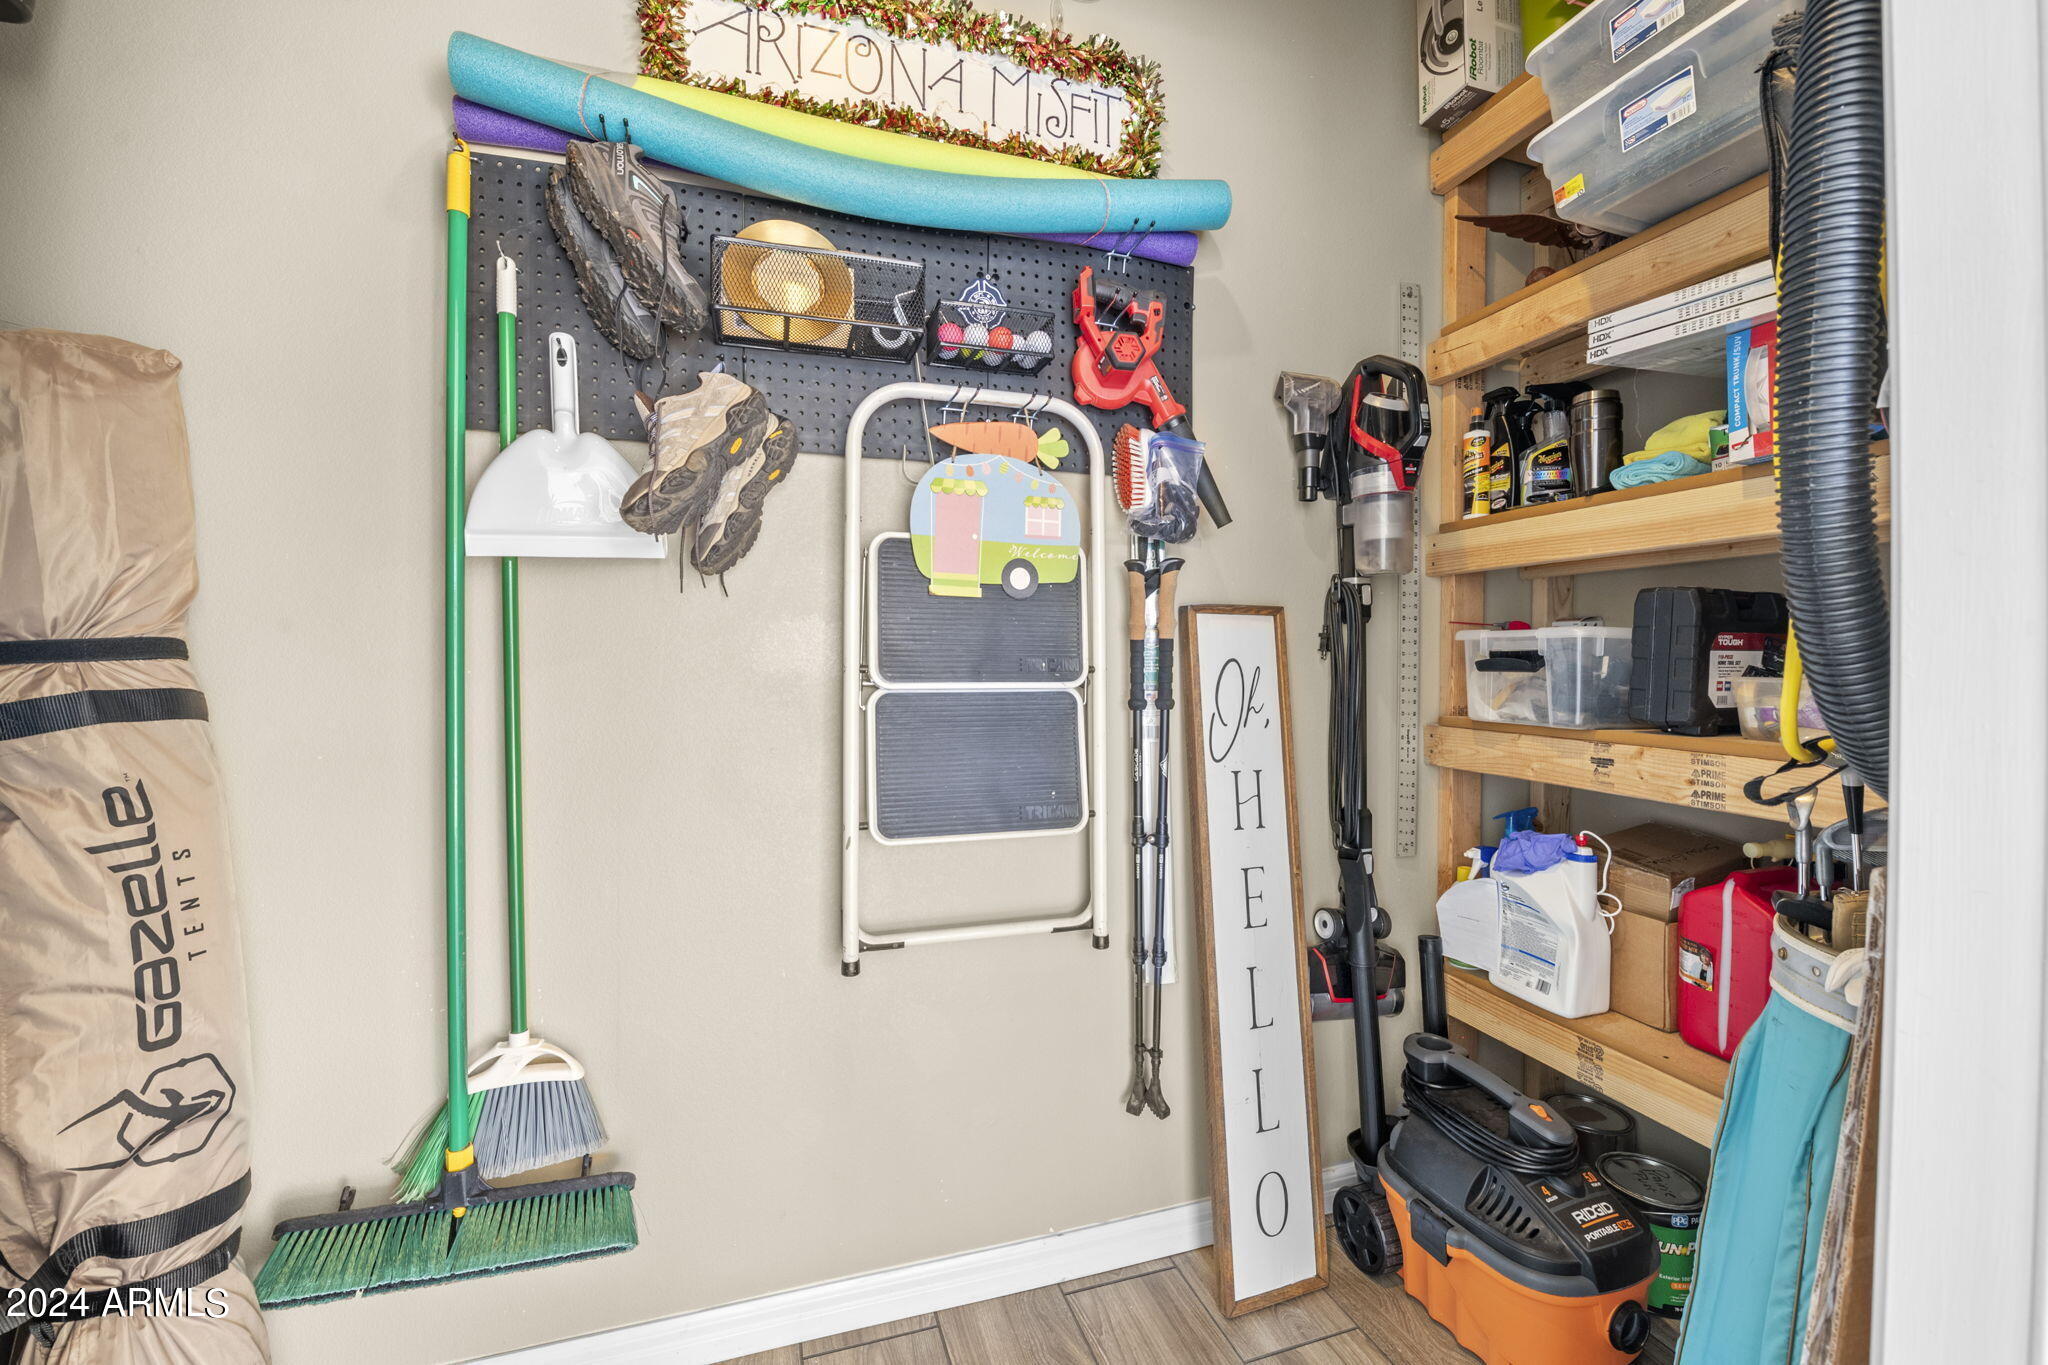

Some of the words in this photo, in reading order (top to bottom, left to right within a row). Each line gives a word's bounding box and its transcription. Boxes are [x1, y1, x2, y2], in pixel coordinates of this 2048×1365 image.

[692, 6, 965, 113] ARIZONA
[1469, 37, 1477, 81] iRobot
[1594, 316, 1612, 328] HDX
[1592, 331, 1612, 344] HDX
[1589, 347, 1609, 359] HDX
[1008, 544, 1079, 560] Welcome
[1209, 658, 1270, 763] Oh,
[1690, 758, 1727, 768] STIMSON
[1701, 769, 1726, 781] PRIME
[1691, 778, 1727, 789] STIMSON
[1701, 789, 1726, 802] PRIME
[1690, 799, 1726, 810] STIMSON
[172, 848, 207, 962] TENTS
[1570, 1201, 1614, 1225] RIDGID
[1584, 1223, 1621, 1242] PORTABLE
